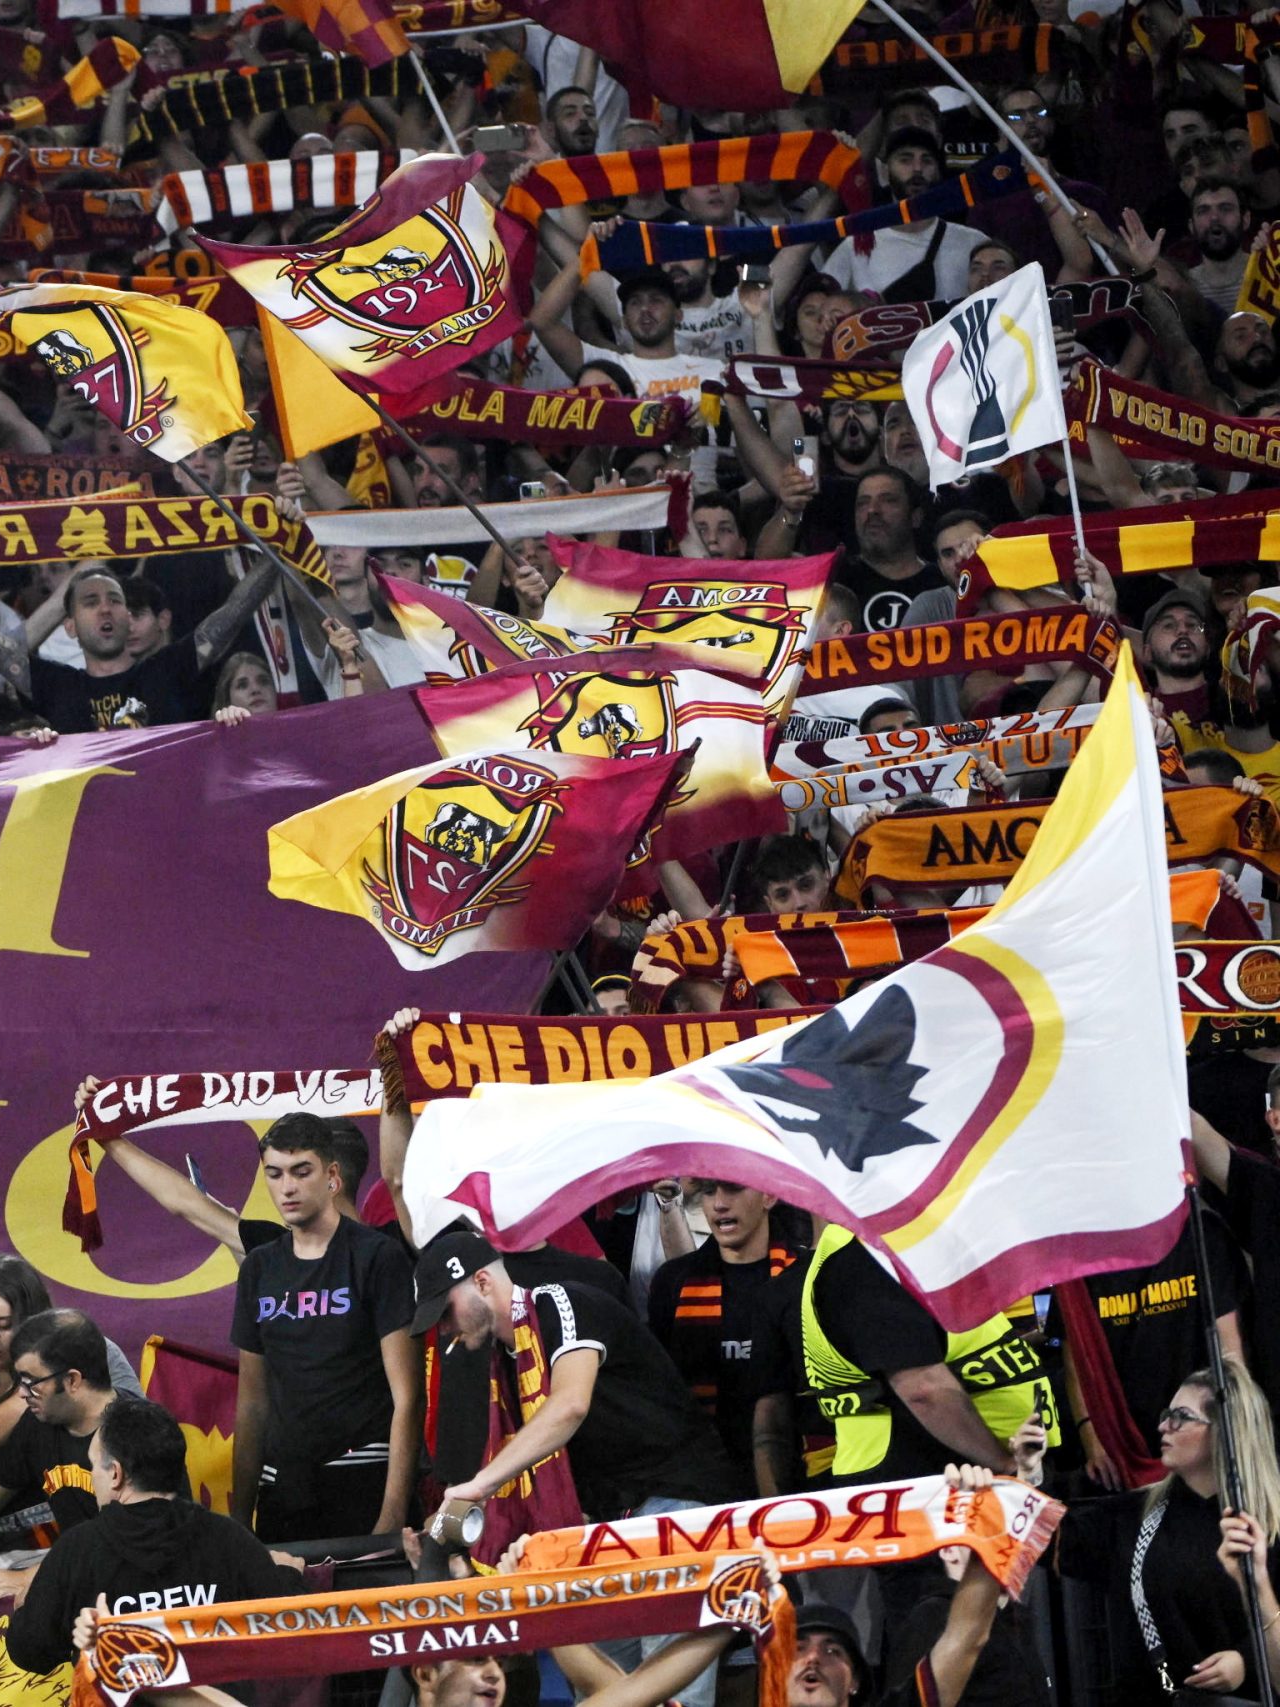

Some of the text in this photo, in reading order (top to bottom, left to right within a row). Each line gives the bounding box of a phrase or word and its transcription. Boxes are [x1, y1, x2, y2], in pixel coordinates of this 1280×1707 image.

[365, 254, 464, 317] 1927
[408, 304, 493, 352] TI AMO
[527, 395, 605, 430] MAI
[1108, 387, 1207, 447] VOGLIO
[47, 467, 156, 499] ROMA
[867, 626, 952, 671] SUD
[964, 613, 1090, 661] ROMA
[412, 1022, 532, 1089] CHE
[539, 1024, 652, 1083] DIO
[93, 1068, 352, 1123] CHE DIO VE
[446, 1256, 465, 1279] 3
[1147, 1275, 1197, 1305] MORTE
[113, 1584, 217, 1616] CREW
[179, 1616, 238, 1640] LA
[245, 1604, 369, 1635] ROMA
[380, 1592, 465, 1624] NON
[478, 1587, 513, 1614] SI
[525, 1564, 701, 1608] DISCUTE
[370, 1619, 520, 1657] SI AMA!
